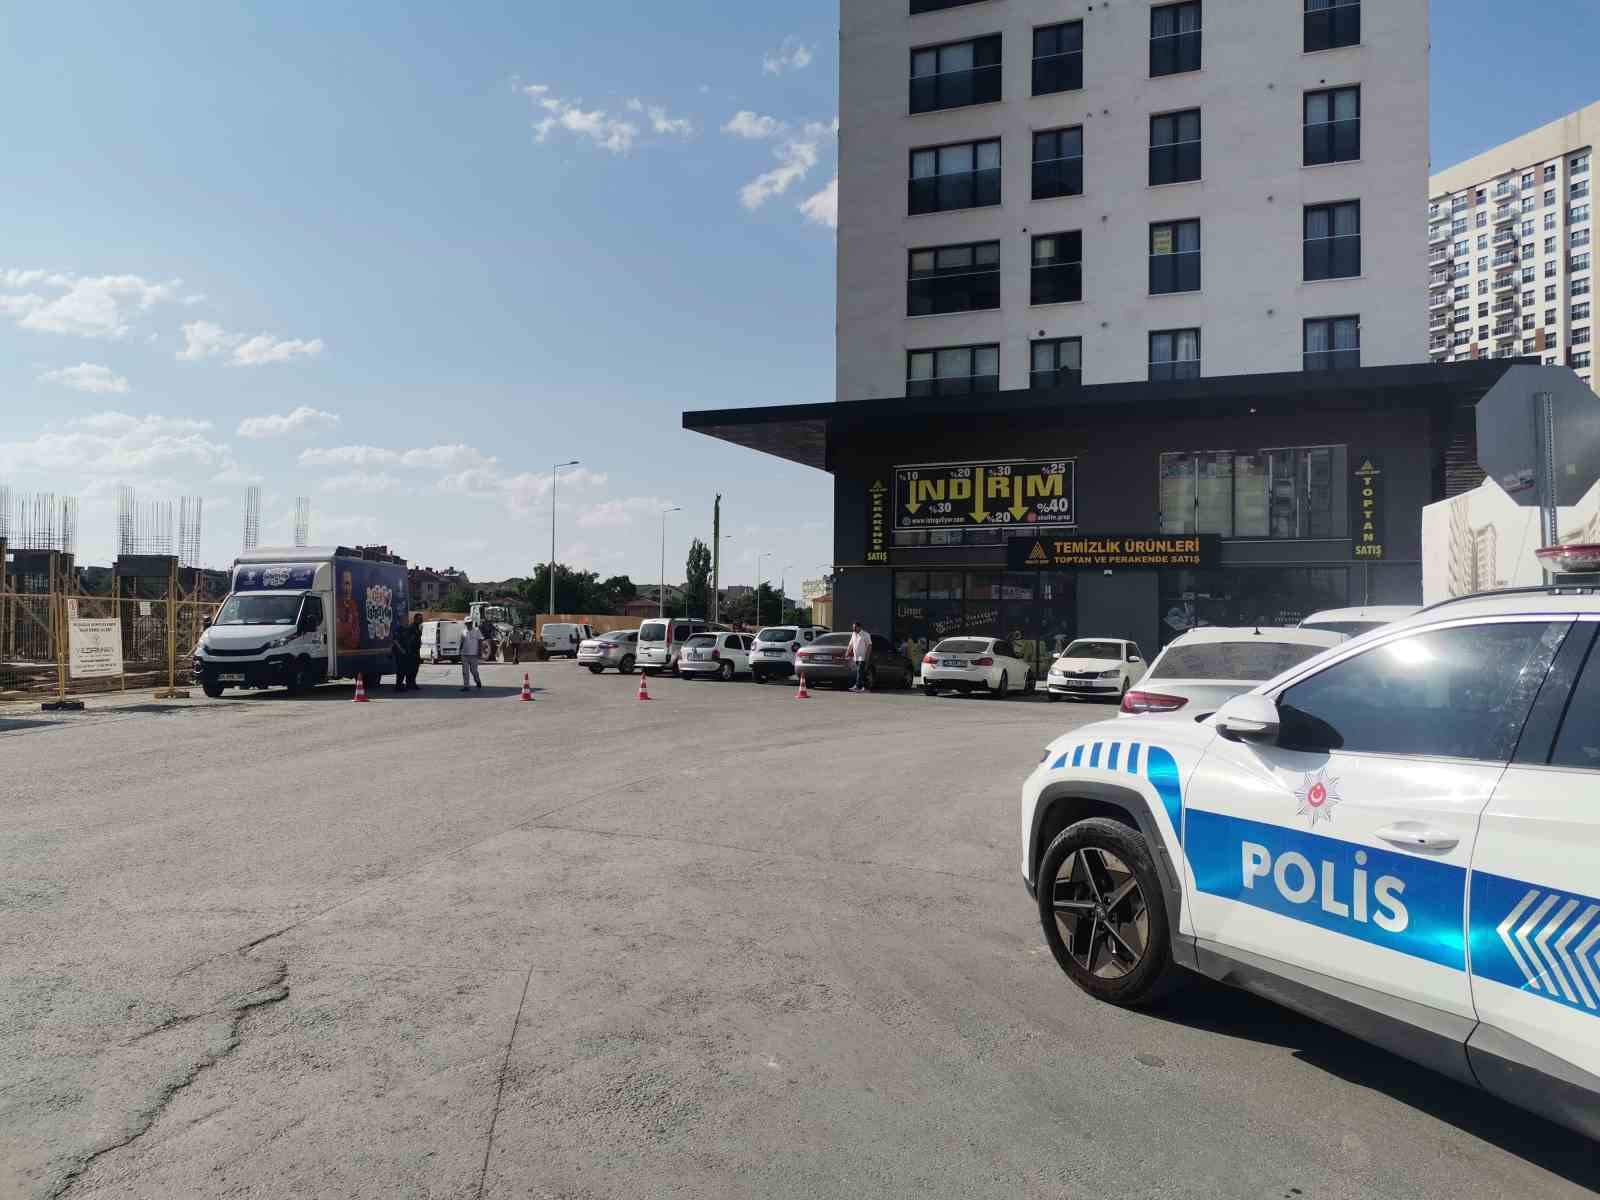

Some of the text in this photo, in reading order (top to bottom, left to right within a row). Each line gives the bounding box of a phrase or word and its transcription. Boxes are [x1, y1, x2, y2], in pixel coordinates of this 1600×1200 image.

[950, 468, 971, 478] %20
[988, 466, 1011, 476] %30
[1041, 463, 1066, 474] %25
[928, 502, 952, 513] %30
[1037, 498, 1068, 513] %40
[1362, 478, 1374, 542] TOPTAN
[987, 511, 1011, 523] %20
[1055, 538, 1200, 553] TEMİZLİK ÜRÜNLERİ
[1354, 545, 1381, 559] SATIŞ
[1054, 556, 1091, 564] TOPTAN
[1095, 556, 1107, 564] VE
[1170, 555, 1200, 565] SATIŞ
[1242, 841, 1409, 933] POLİS
